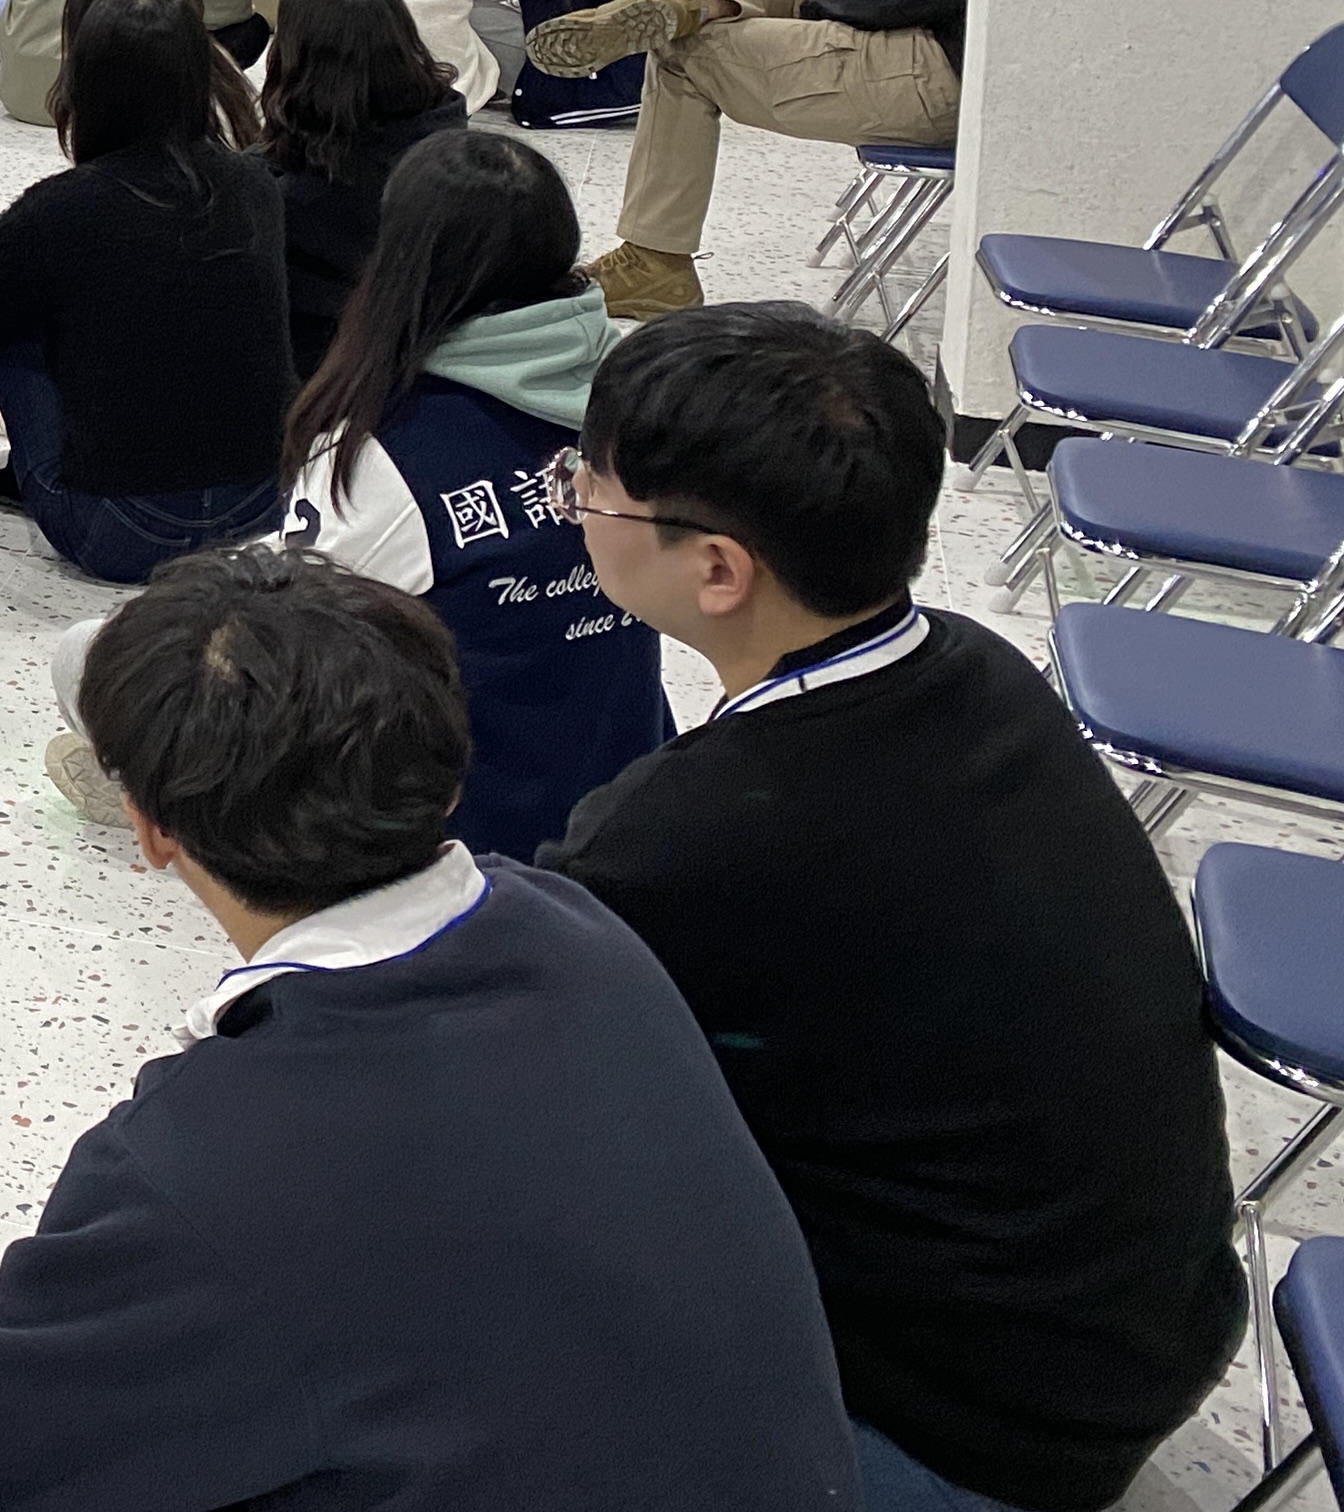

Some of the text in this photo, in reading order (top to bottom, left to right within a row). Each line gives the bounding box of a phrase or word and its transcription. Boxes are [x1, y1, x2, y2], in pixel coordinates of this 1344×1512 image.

[488, 564, 602, 606] The colleg
[564, 611, 616, 641] since
